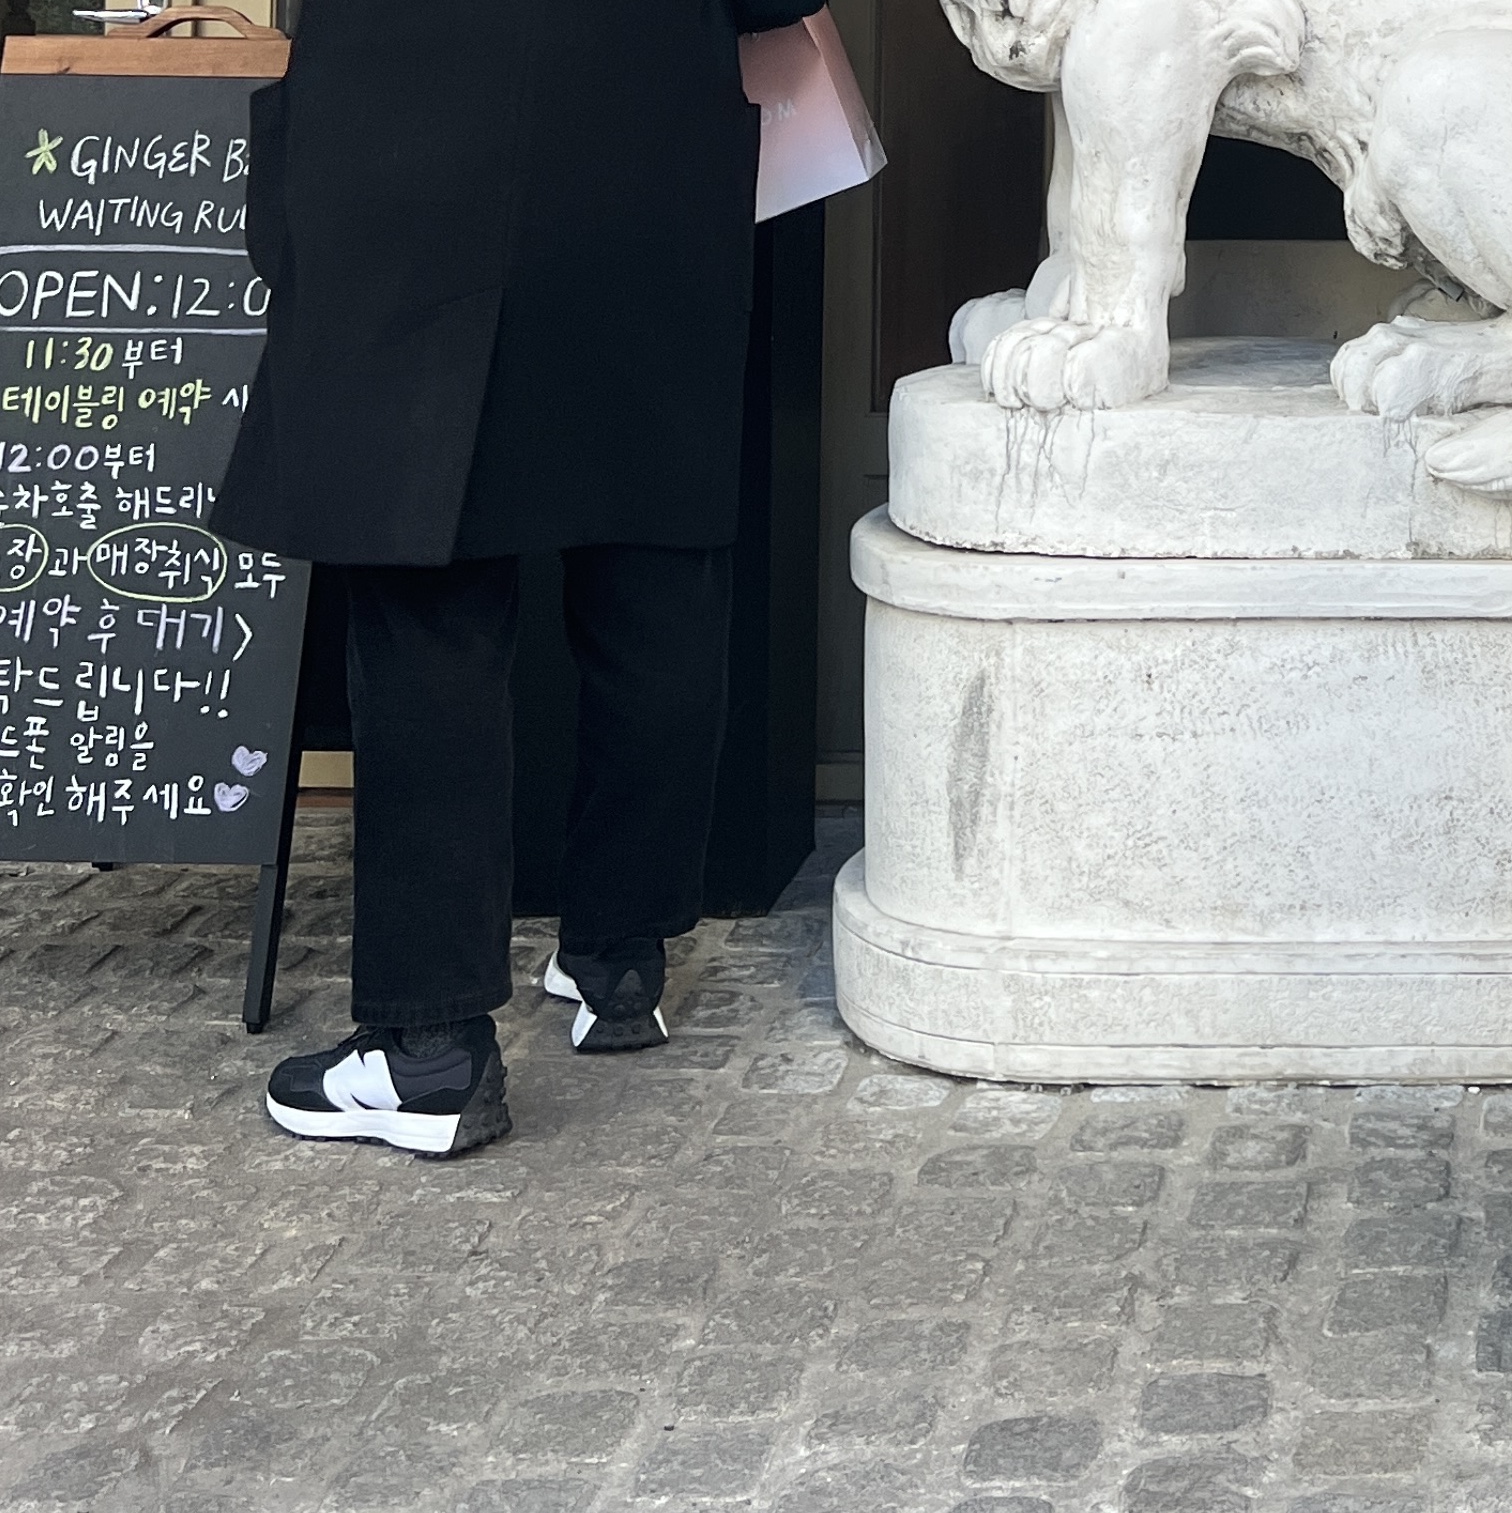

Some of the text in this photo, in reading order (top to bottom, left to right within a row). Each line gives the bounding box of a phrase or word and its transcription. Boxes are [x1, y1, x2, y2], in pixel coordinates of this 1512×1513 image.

[70, 129, 250, 185] GINGER B
[39, 196, 183, 236] WAITING
[2, 385, 124, 430] 테이블링
[138, 379, 212, 426] 예약
[234, 552, 286, 598] 모두
[88, 598, 120, 654] 후
[70, 721, 154, 771] 알림을
